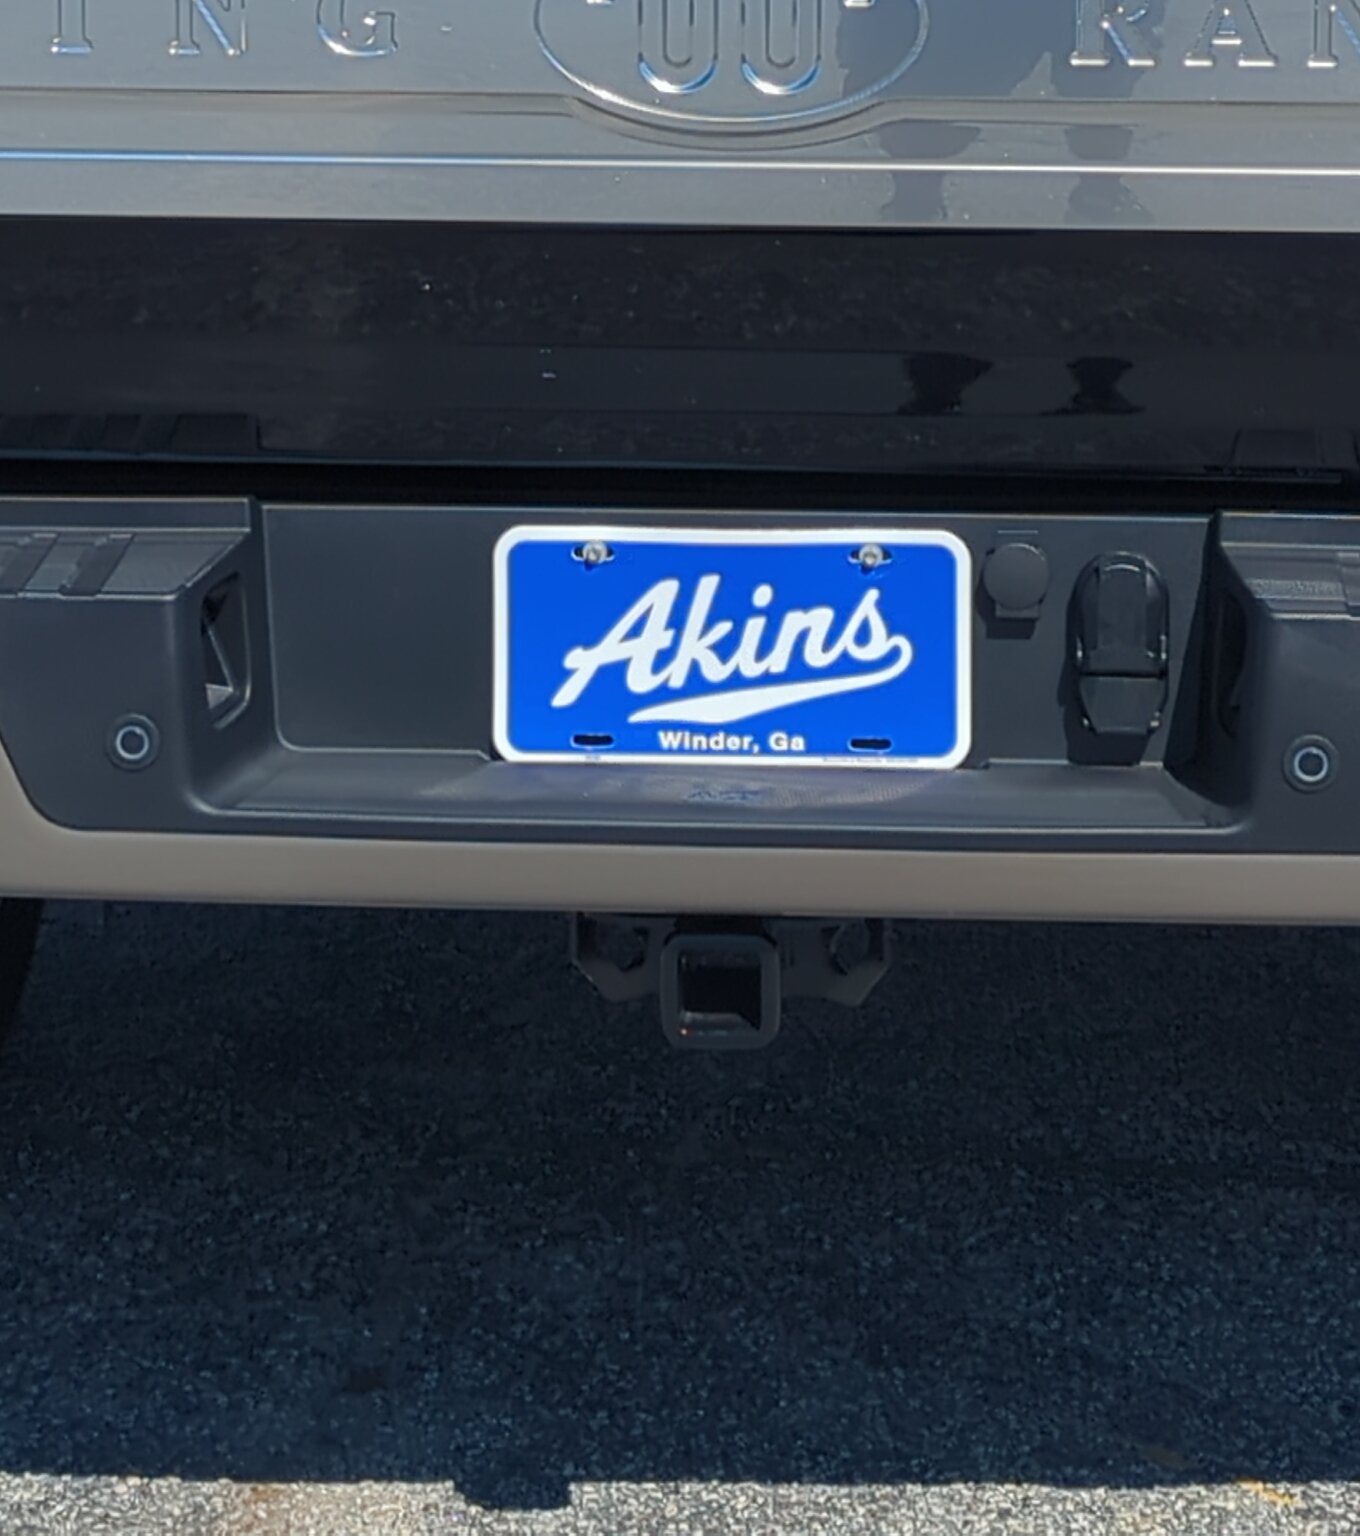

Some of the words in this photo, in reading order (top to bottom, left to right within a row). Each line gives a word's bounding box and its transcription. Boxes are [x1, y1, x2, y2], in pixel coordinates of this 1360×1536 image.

[551, 574, 914, 723] Akins
[658, 729, 760, 754] Winder,
[768, 731, 806, 752] Ga
